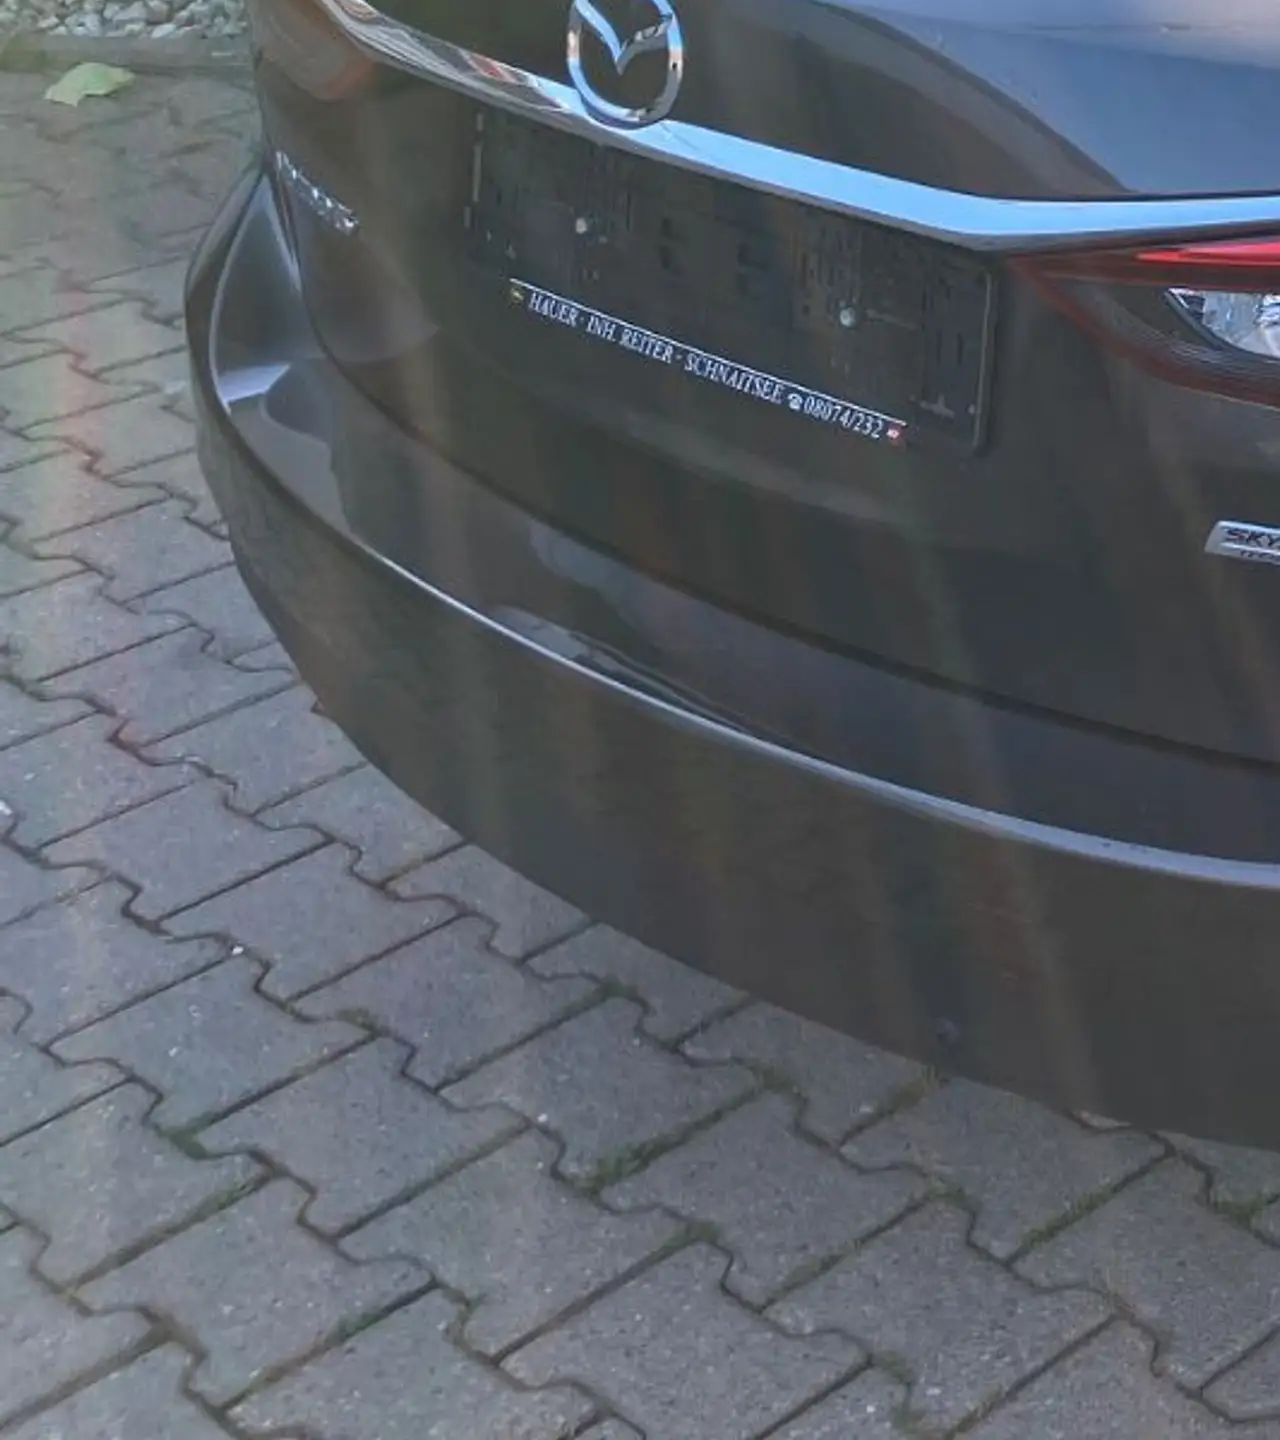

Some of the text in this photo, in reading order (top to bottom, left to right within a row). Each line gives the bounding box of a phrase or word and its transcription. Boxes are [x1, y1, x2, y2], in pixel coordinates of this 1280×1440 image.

[528, 291, 884, 439] HAUER INH. REITER SCHNAITSEE 08074/232
